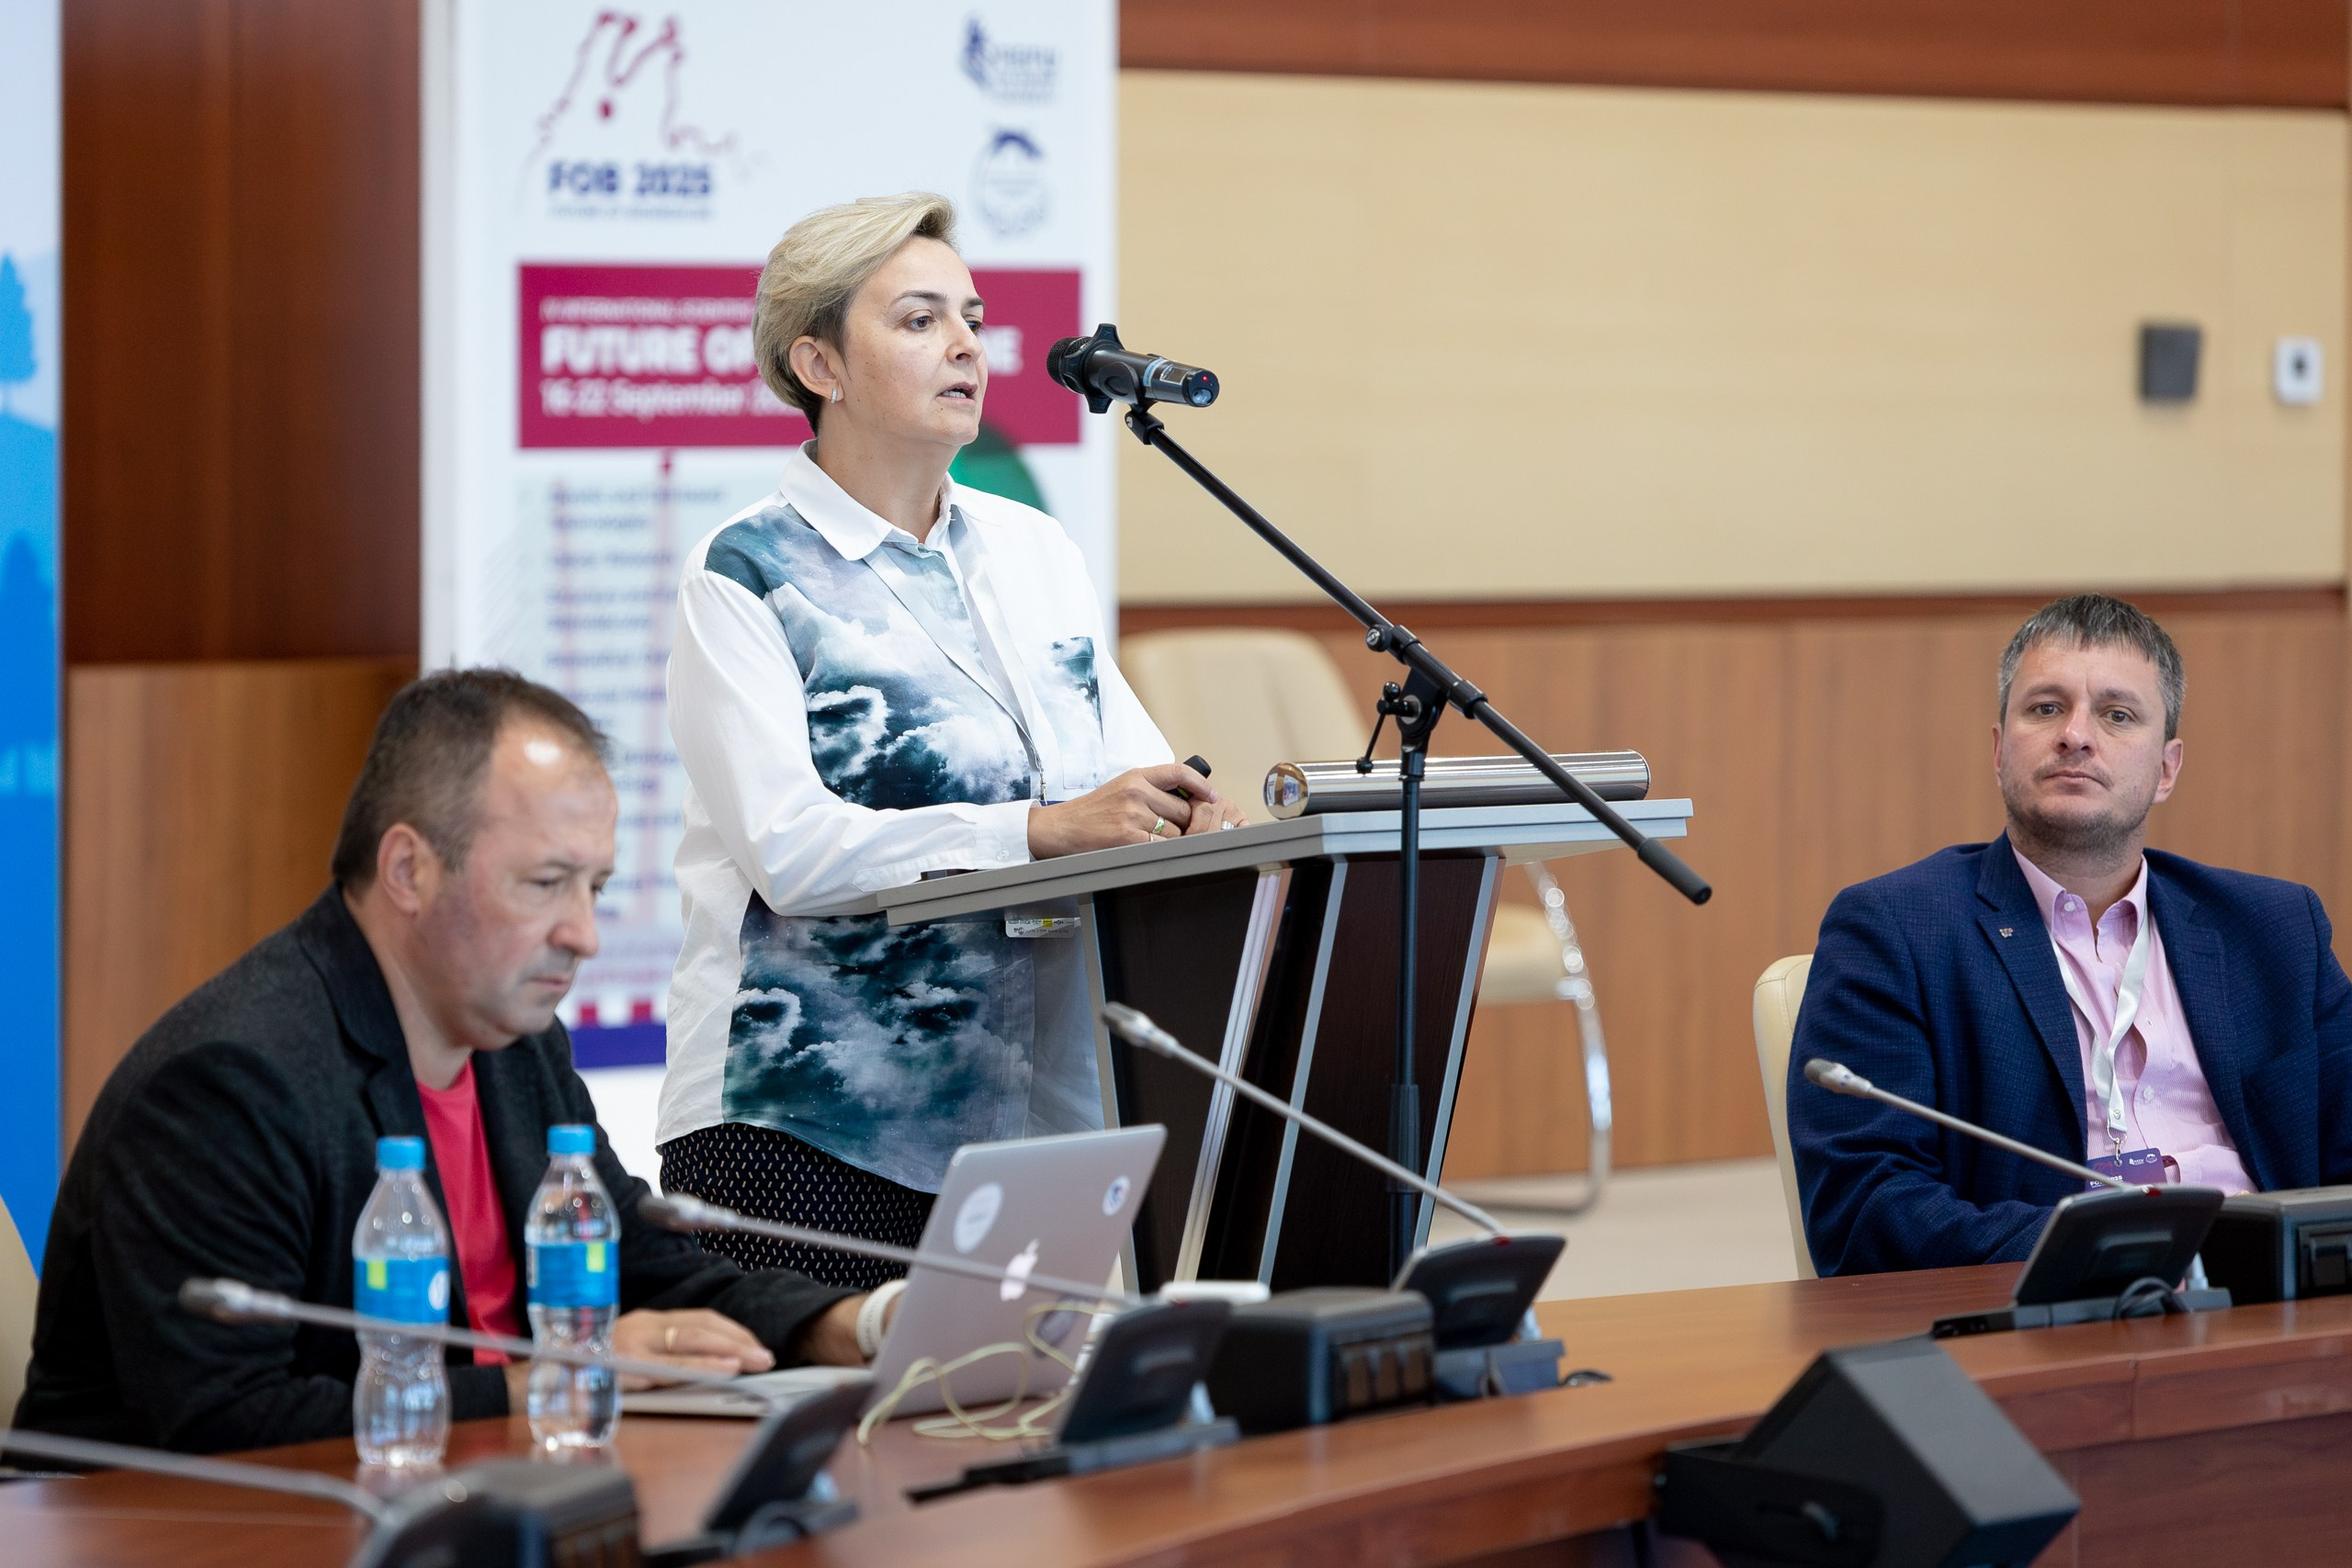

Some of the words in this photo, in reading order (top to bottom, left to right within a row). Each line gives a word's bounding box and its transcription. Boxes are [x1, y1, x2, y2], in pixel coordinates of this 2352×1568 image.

[550, 163, 617, 195] FOB
[638, 164, 710, 195] 2025
[542, 326, 698, 373] FUTURE
[611, 378, 744, 422] September
